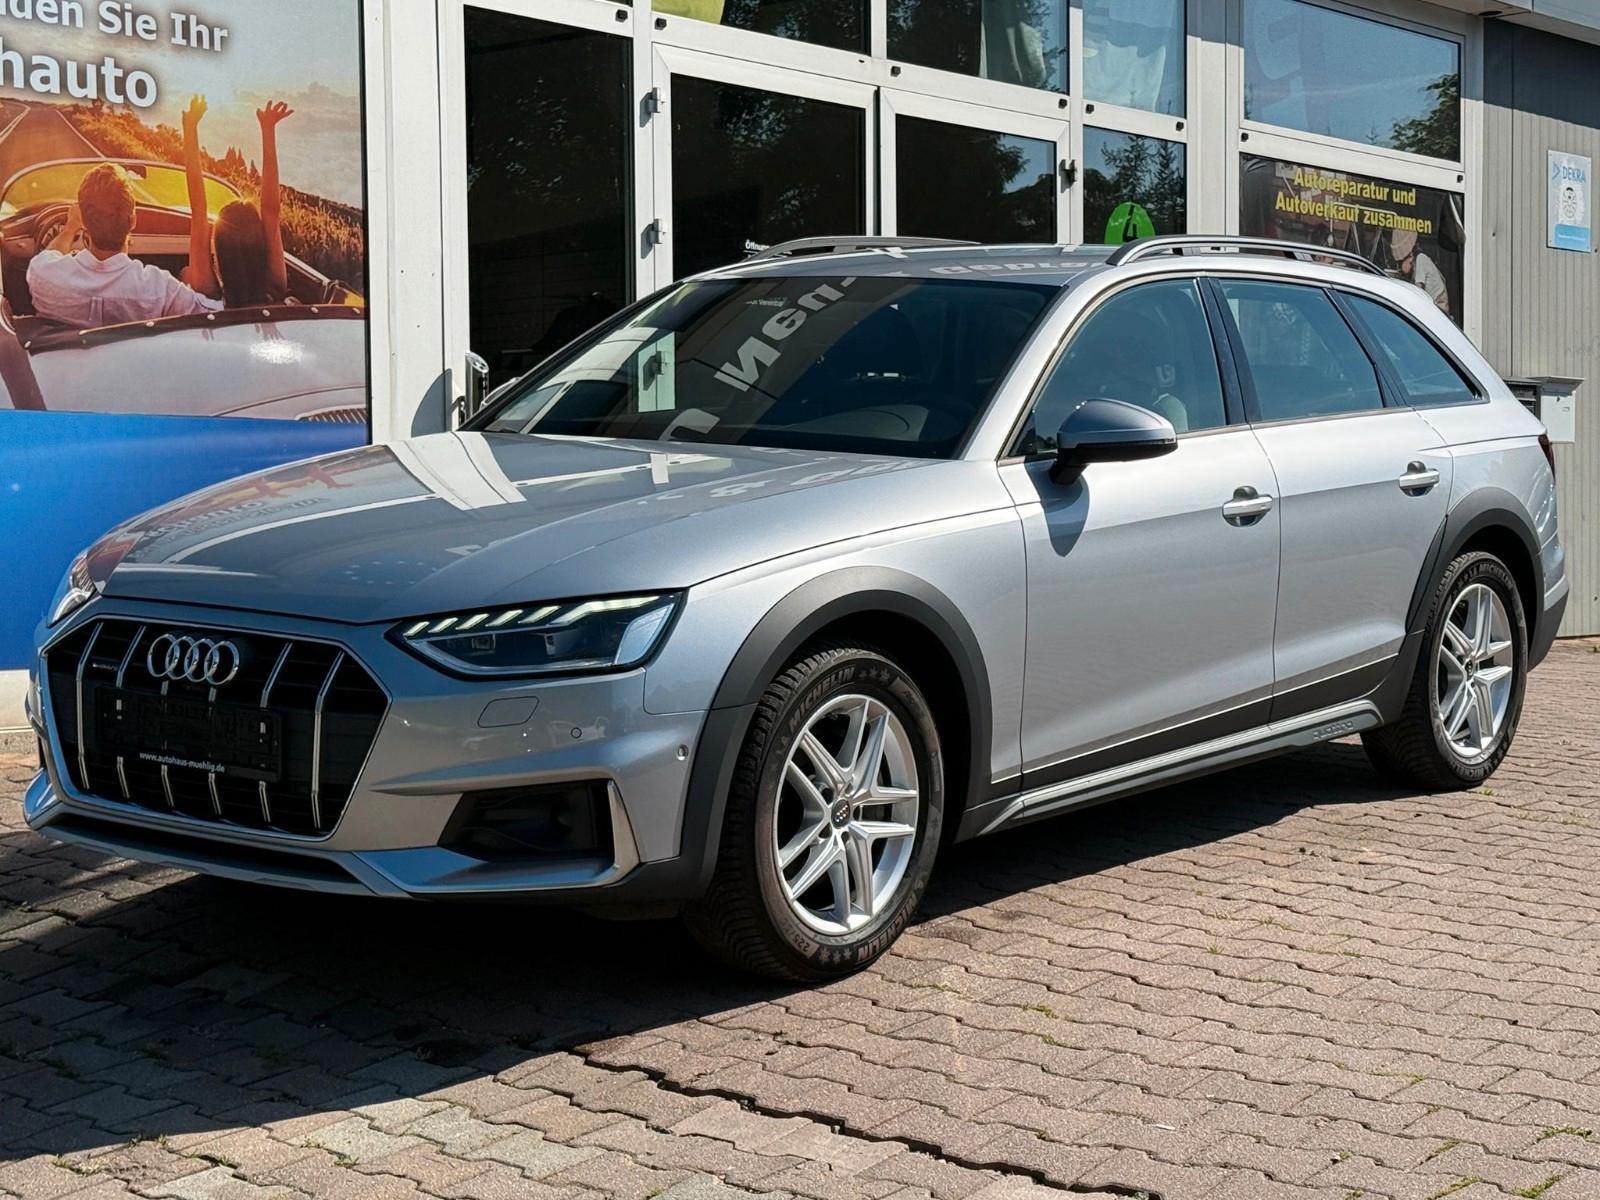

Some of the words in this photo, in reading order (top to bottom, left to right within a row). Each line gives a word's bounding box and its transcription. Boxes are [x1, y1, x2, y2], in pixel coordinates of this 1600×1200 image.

[0, 0, 84, 28] den
[98, 0, 157, 40] Sie
[170, 12, 228, 51] Ihr
[1294, 168, 1390, 202] Autoreparatur
[1392, 186, 1417, 206] und
[1562, 165, 1587, 184] DEKRA
[1275, 191, 1361, 223] Autoverkauf
[1363, 212, 1433, 235] zusammen
[788, 666, 856, 733] MICHELIN
[857, 890, 917, 961] MICHELIN
